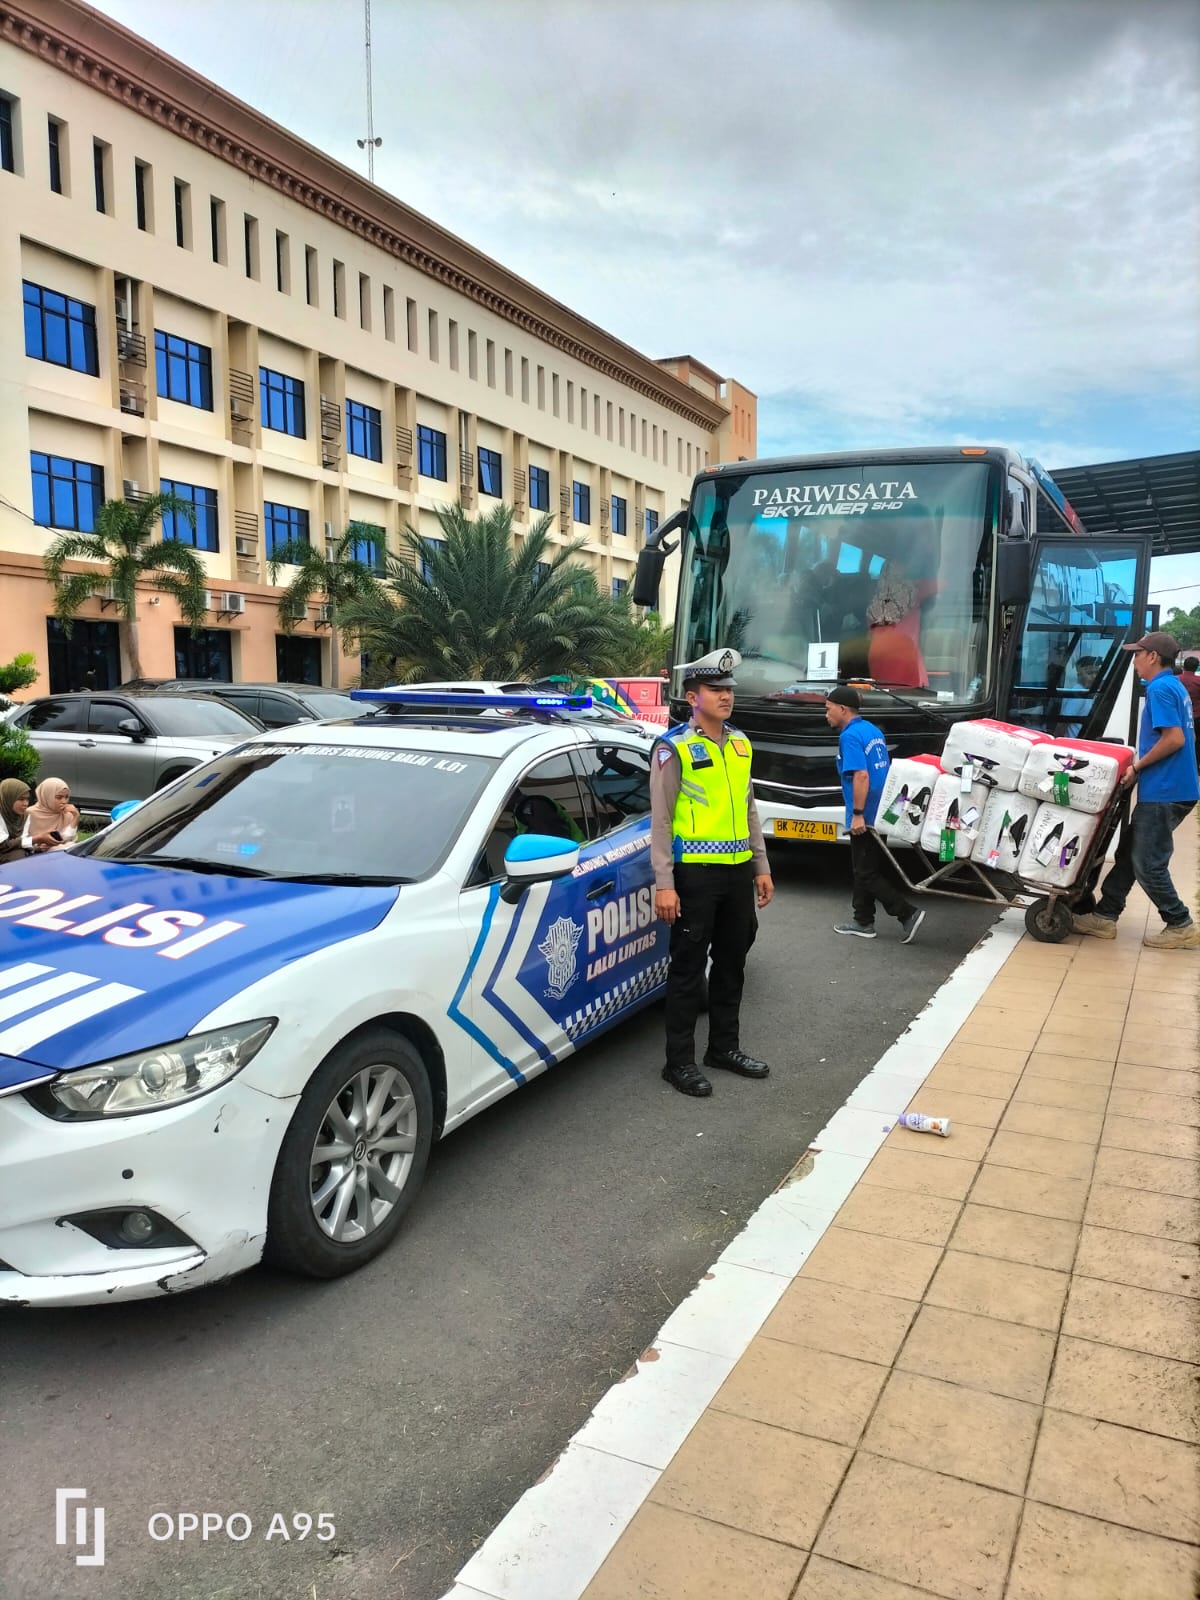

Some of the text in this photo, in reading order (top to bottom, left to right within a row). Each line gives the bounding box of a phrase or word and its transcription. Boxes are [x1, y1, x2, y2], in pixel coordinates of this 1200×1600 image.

[752, 481, 918, 506] PARIWISATA
[761, 501, 904, 519] SKYLINER SHD
[816, 650, 829, 669] 1
[338, 748, 396, 761] TANJUNG
[391, 752, 433, 767] BALAI
[433, 759, 468, 774] K.01
[776, 820, 834, 836] BK 7242 UA
[0, 884, 247, 960] OLISI
[586, 930, 657, 982] LALU LINTAS
